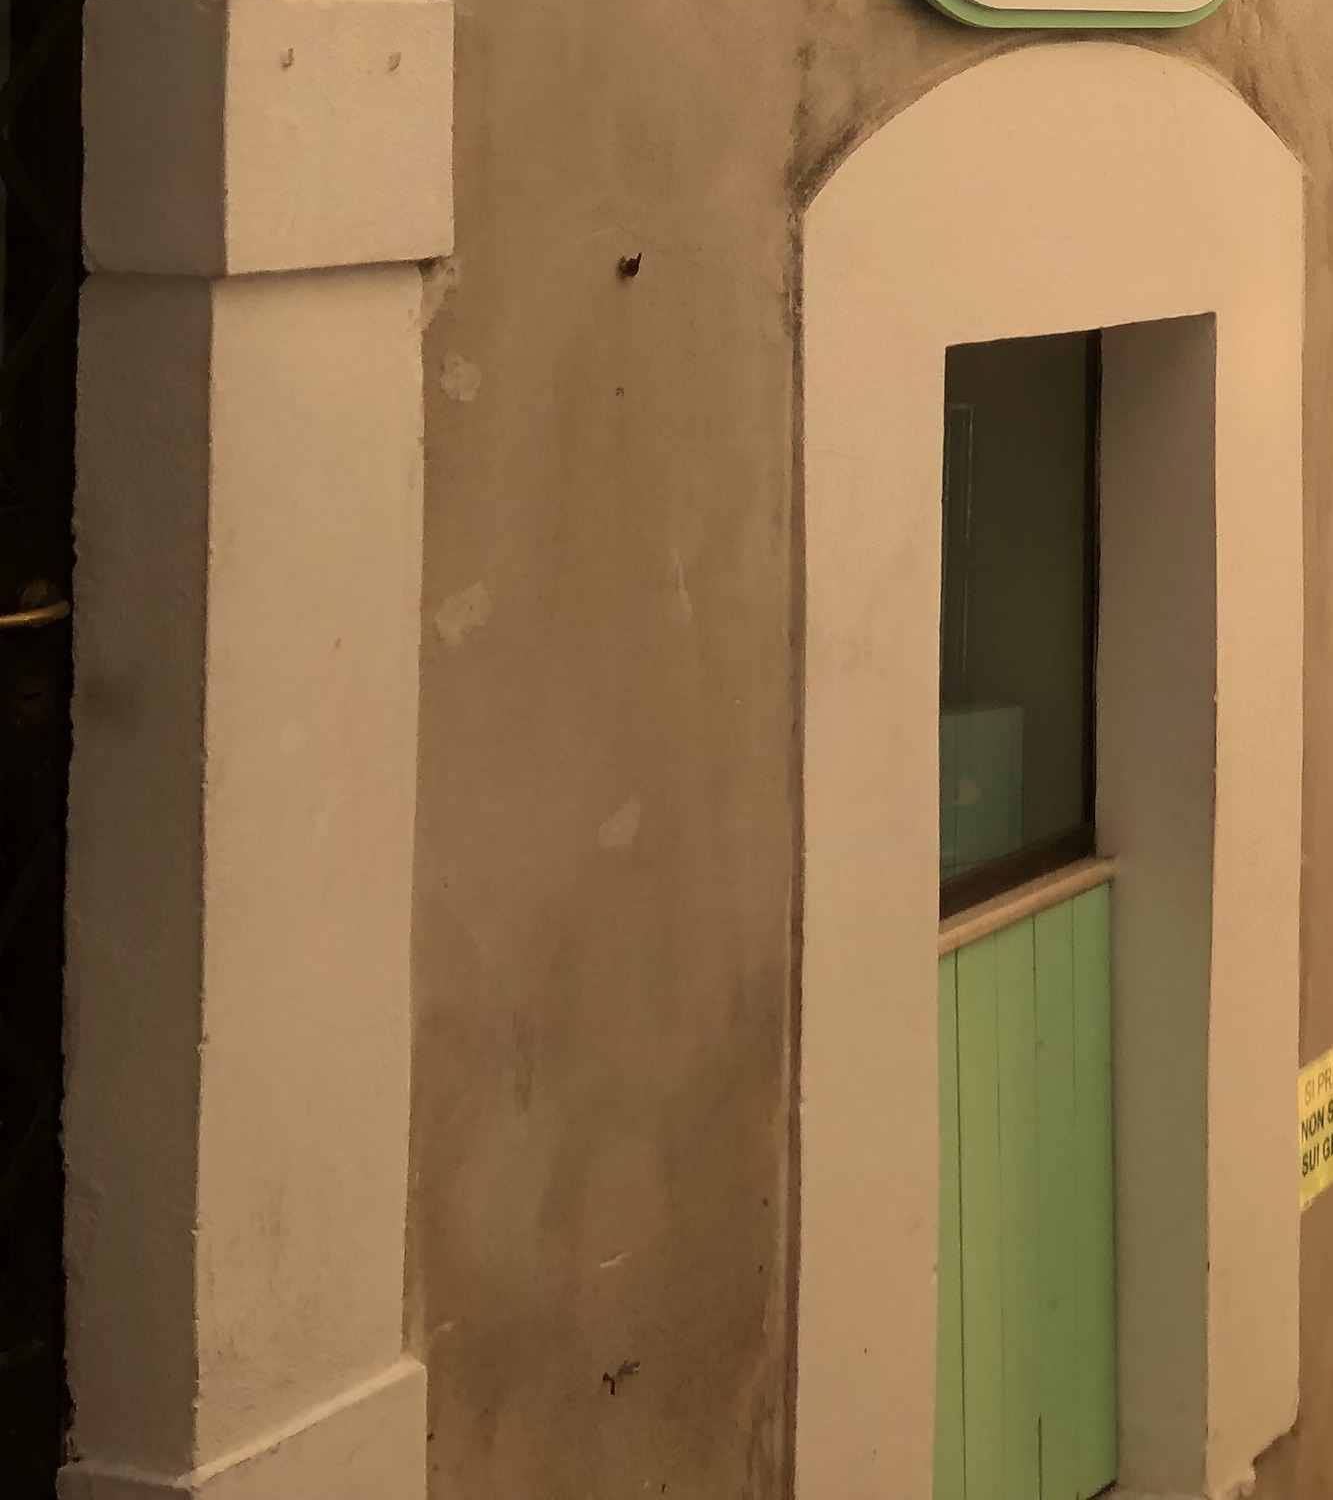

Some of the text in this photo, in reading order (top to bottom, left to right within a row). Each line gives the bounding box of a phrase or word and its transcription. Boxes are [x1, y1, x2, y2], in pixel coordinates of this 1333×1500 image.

[1303, 1079, 1315, 1106] SI
[1301, 1107, 1325, 1143] NON
[1301, 1144, 1320, 1179] SUI
